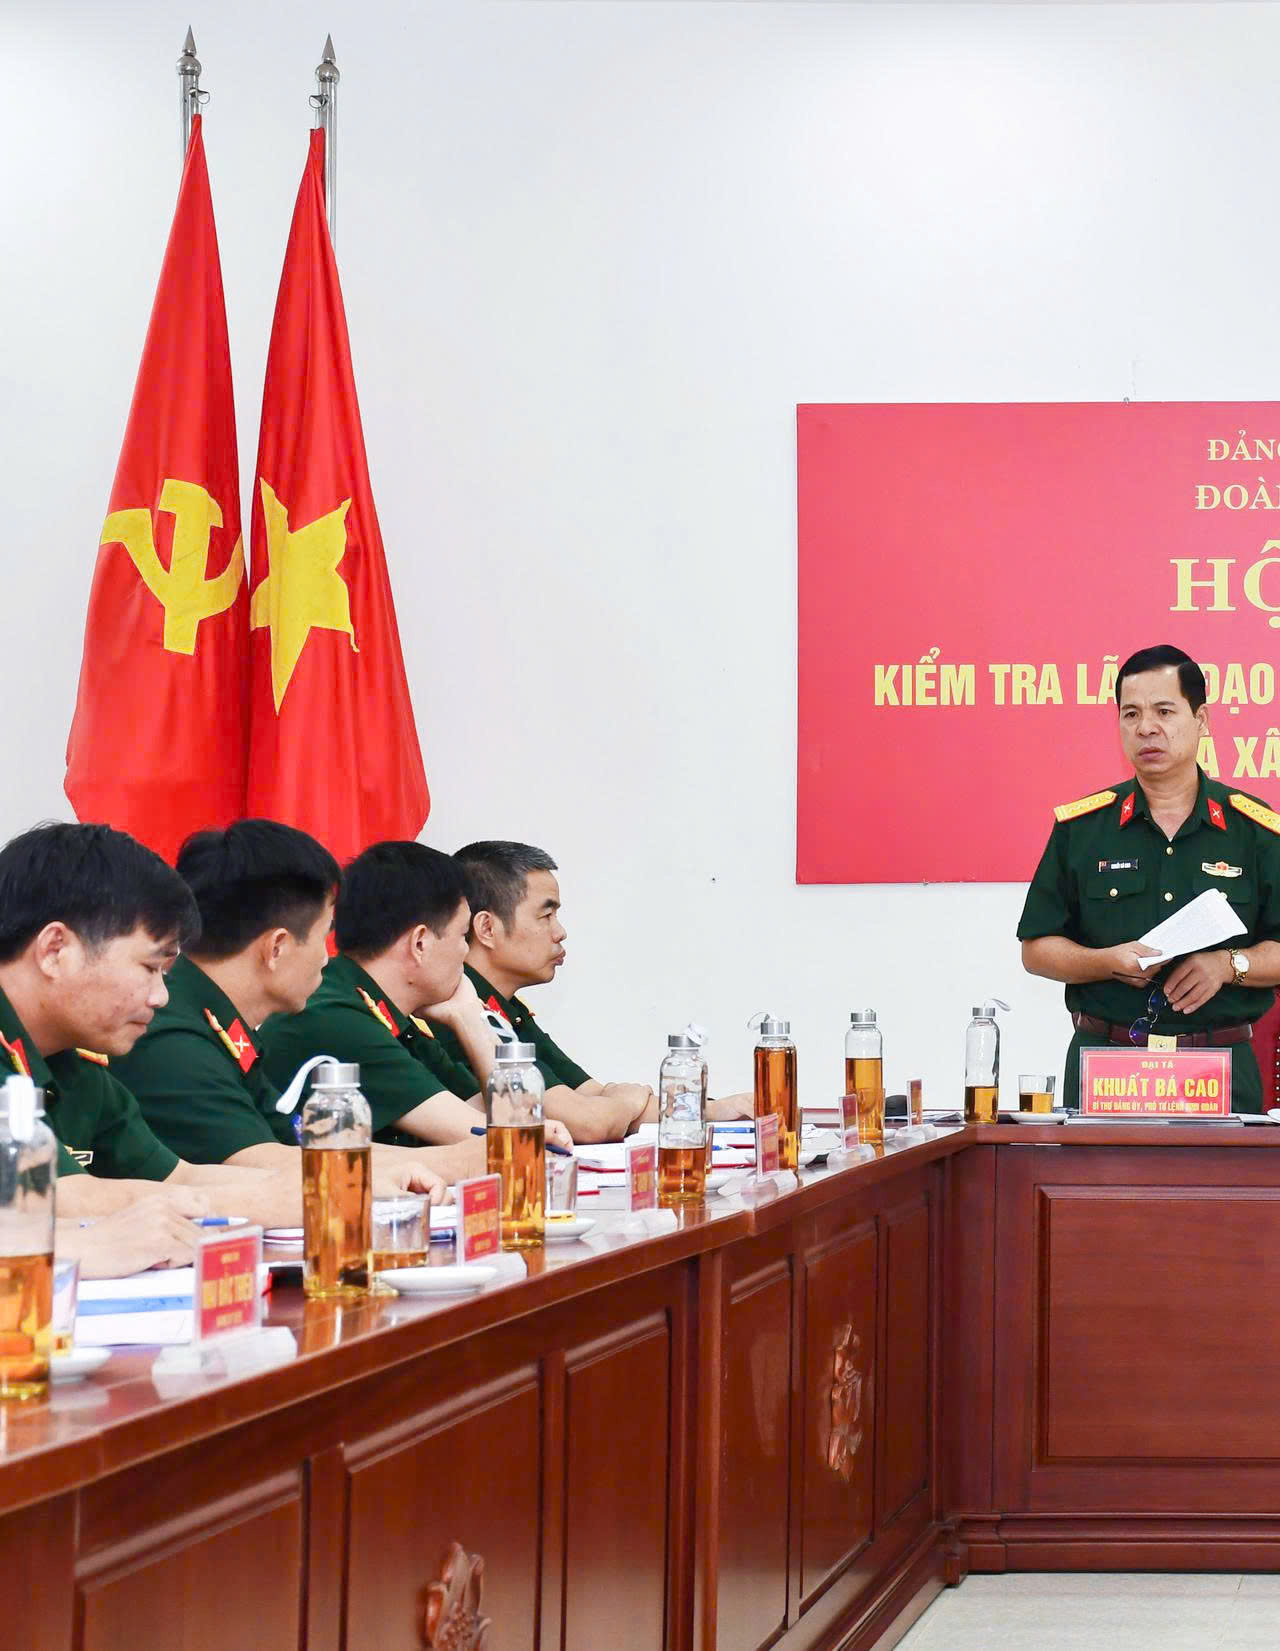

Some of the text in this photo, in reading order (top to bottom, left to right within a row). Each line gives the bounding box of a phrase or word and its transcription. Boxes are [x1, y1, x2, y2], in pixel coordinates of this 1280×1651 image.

[874, 647, 976, 706] KIỂM
[988, 664, 1064, 705] TRA
[1076, 655, 1120, 705] LÃ
[1199, 663, 1275, 714] ĐẠO
[1196, 729, 1220, 778] À
[1093, 1072, 1219, 1098] KHUẤT BÁ CAO
